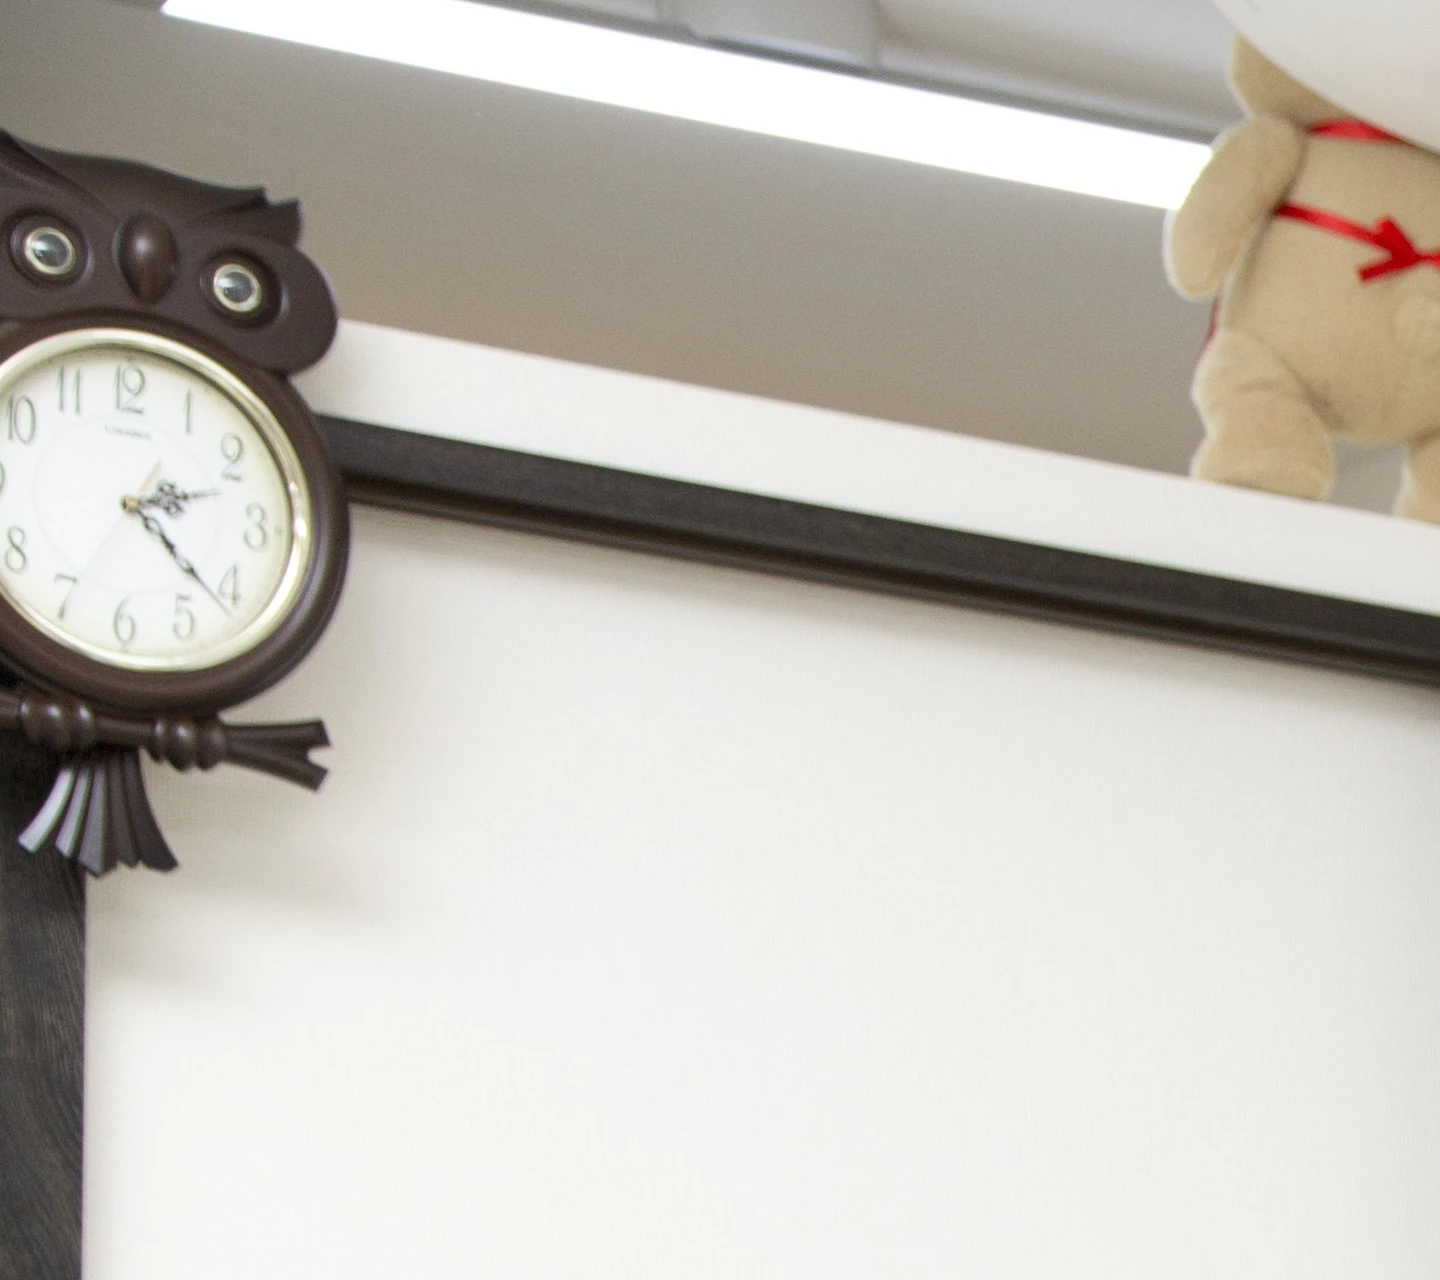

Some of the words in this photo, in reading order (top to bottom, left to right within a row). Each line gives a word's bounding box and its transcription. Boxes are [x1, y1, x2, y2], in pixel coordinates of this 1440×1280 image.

[57, 365, 80, 414] 11
[113, 364, 145, 414] 12
[184, 388, 191, 434] 1
[6, 394, 36, 445] 10
[220, 432, 243, 481] 2
[4, 525, 26, 573] 8
[244, 503, 267, 551] 3
[54, 572, 77, 619] 7
[218, 563, 241, 606] 4
[112, 593, 135, 644] 6
[173, 592, 195, 641] 5
